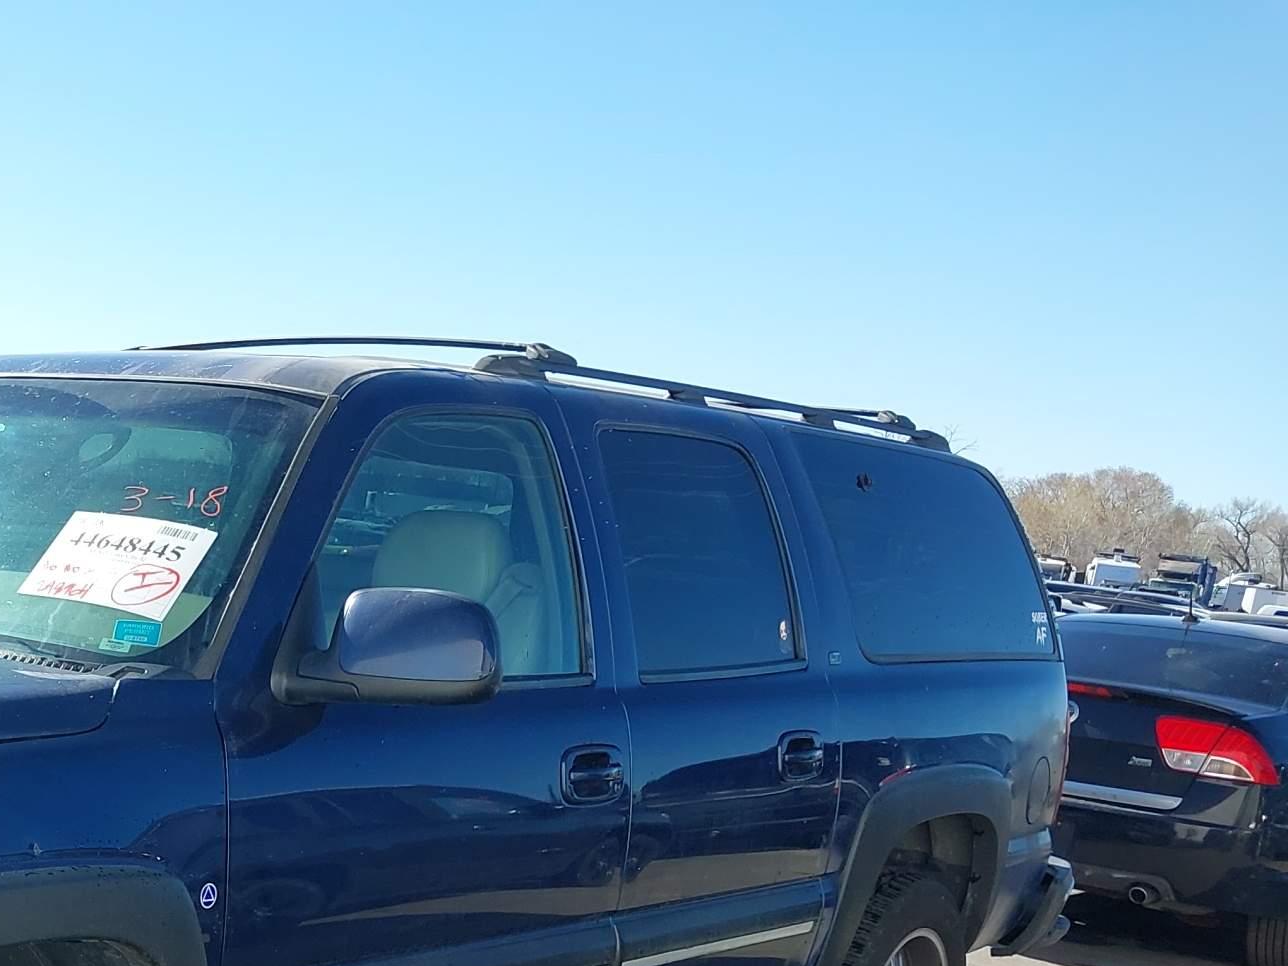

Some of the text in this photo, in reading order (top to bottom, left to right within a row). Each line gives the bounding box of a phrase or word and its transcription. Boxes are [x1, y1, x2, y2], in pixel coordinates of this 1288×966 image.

[119, 486, 229, 517] 3-18
[70, 532, 187, 562] 44648445
[1035, 626, 1048, 647] AF
